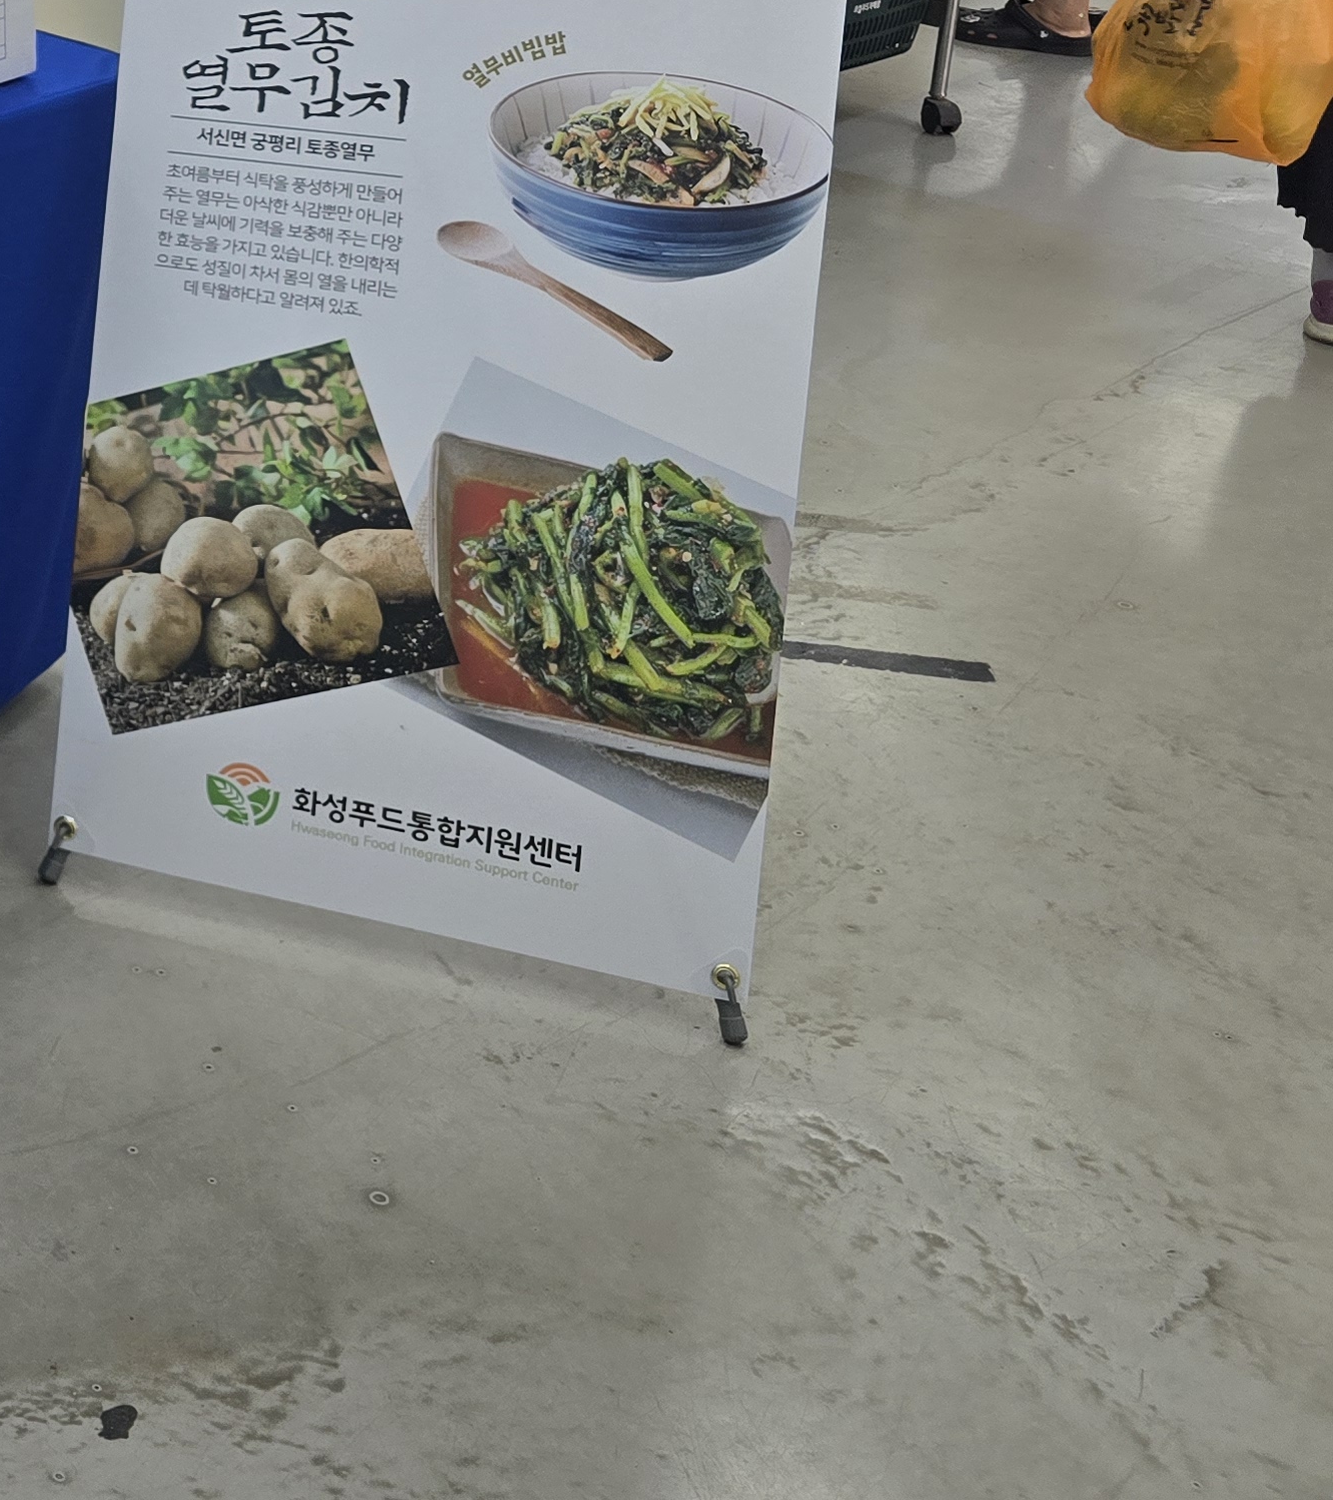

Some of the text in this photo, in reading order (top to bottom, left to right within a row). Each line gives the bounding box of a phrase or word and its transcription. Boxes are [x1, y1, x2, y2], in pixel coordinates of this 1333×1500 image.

[227, 10, 355, 64] 토종
[463, 31, 567, 89] 열무비빔밥
[183, 54, 412, 124] 열무김치
[197, 128, 375, 161] 서신면 궁평리 토종열무
[166, 164, 403, 204] 초여름부터 식탁을 풍성하게 만들어
[162, 186, 403, 227] 주는 열무는 아삭한 식감뿐만 아니라
[160, 208, 403, 252] 더운 날씨에 기력을 보충해 주는 다양
[158, 231, 399, 274] 한 효능을 가지고 있습니다. 한의학적
[154, 253, 397, 298] 으로도 성질이 차서 몸의 열을 내리는
[184, 281, 362, 316] 데 탁월하다고 알려져 있죠.
[292, 787, 583, 872] 화성푸드통합지원센터
[291, 820, 579, 892] Hwaseong Food Integration Support Center
